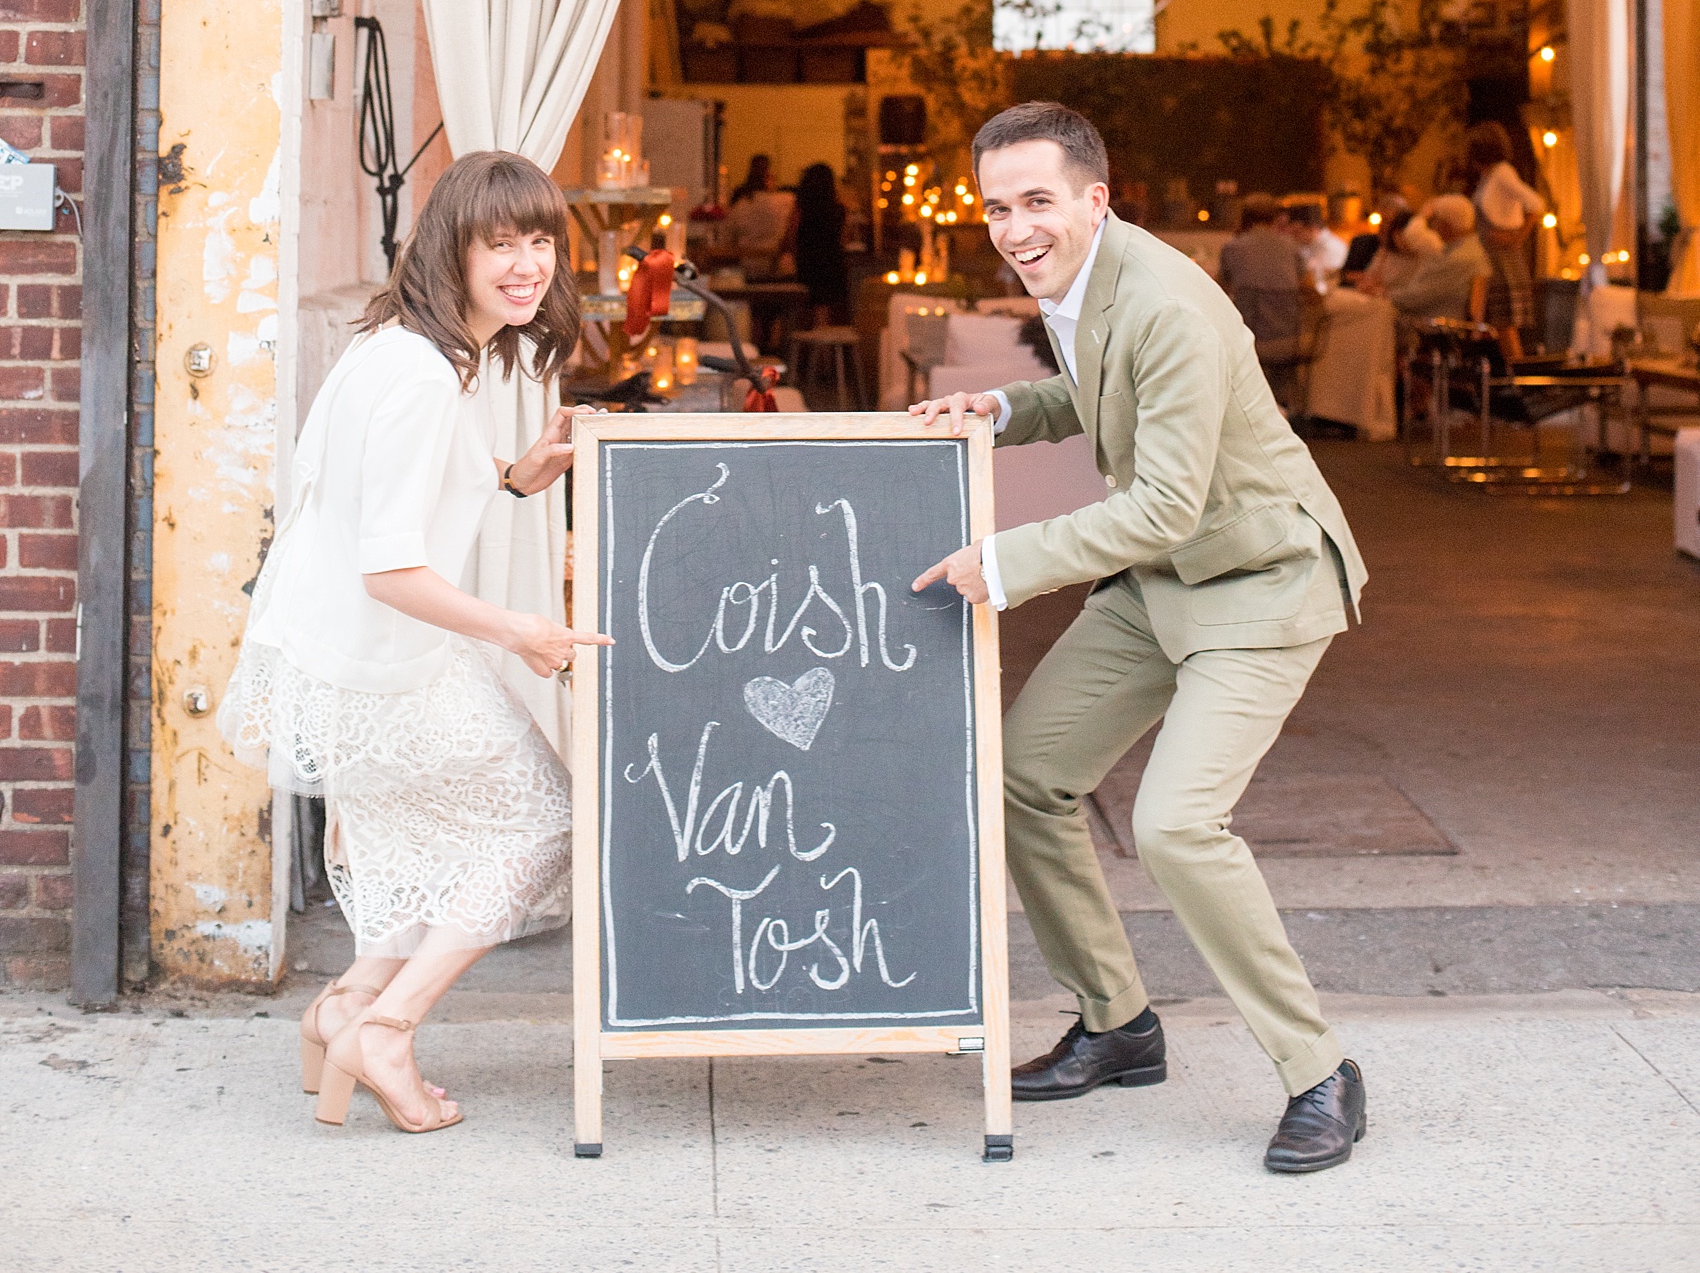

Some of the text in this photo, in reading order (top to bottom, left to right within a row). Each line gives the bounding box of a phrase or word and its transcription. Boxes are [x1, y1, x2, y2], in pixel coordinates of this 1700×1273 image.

[638, 462, 917, 673] Coish
[624, 721, 836, 862] Van
[686, 864, 917, 994] Tosh
